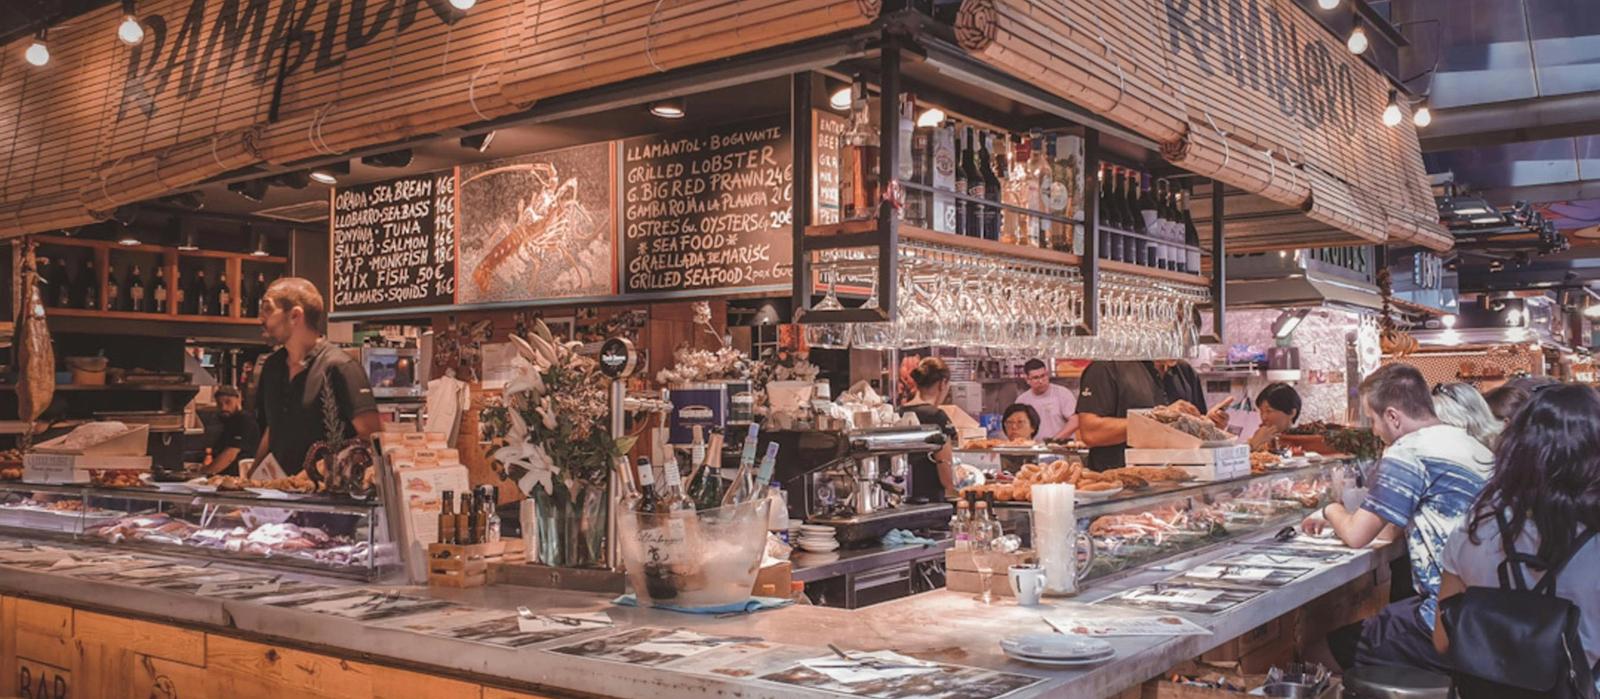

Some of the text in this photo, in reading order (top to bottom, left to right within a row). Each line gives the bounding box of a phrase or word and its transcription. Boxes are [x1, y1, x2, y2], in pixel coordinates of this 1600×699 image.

[710, 126, 781, 150] BOGAVANTE
[627, 145, 777, 184] GRILLED LOBSTER
[394, 179, 432, 201] BREAM
[672, 178, 706, 197] RED
[710, 168, 765, 192] PRAWN
[382, 220, 421, 238] TUNA
[627, 220, 680, 239] OSTRES
[700, 213, 759, 234] OYSTERS
[380, 235, 430, 254] SALMON
[334, 257, 365, 275] RAP
[629, 252, 706, 273] GRAELLADA
[720, 244, 770, 266] MARISC
[629, 270, 682, 289] GRILLED
[684, 267, 743, 288] SEAFOOD
